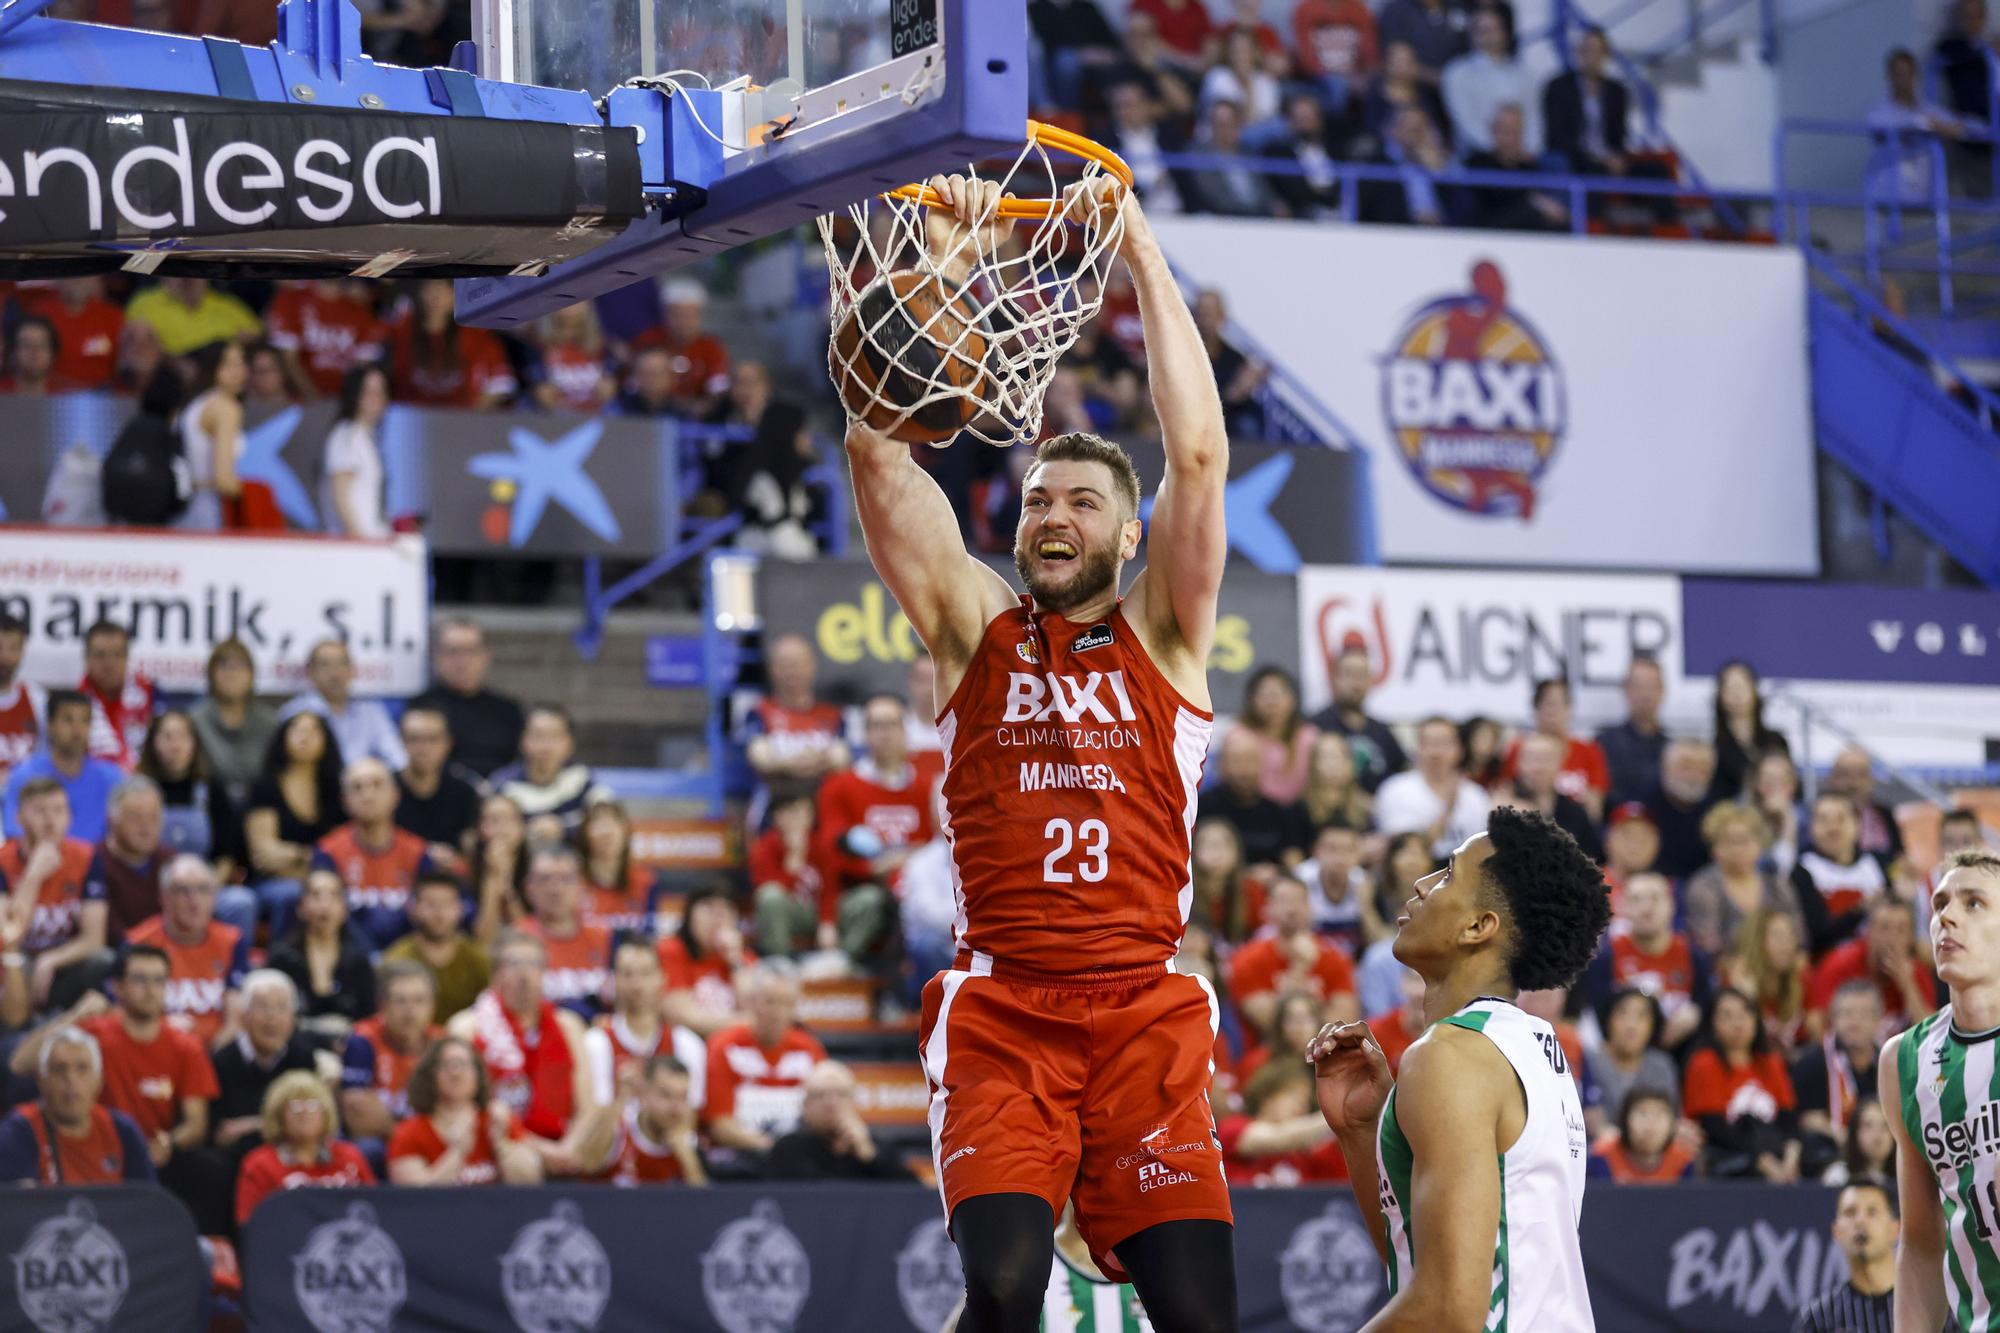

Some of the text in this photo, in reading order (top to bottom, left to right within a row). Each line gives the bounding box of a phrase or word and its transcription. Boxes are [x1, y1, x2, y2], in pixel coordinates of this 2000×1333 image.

[0, 117, 441, 231] ndesa
[1392, 359, 1558, 428] BAXI
[1075, 635, 1110, 650] endesa
[1868, 619, 2000, 657] VOL
[1002, 669, 1137, 724] BAXI
[997, 724, 1141, 750] CLIMATIZACIÓN
[1019, 761, 1126, 794] MANRESA
[1042, 817, 1110, 884] 23
[1138, 1161, 1170, 1181] ETL
[1139, 1171, 1199, 1193] GLOBAL
[24, 1259, 121, 1289] BAXI
[304, 1261, 398, 1291] BAXI
